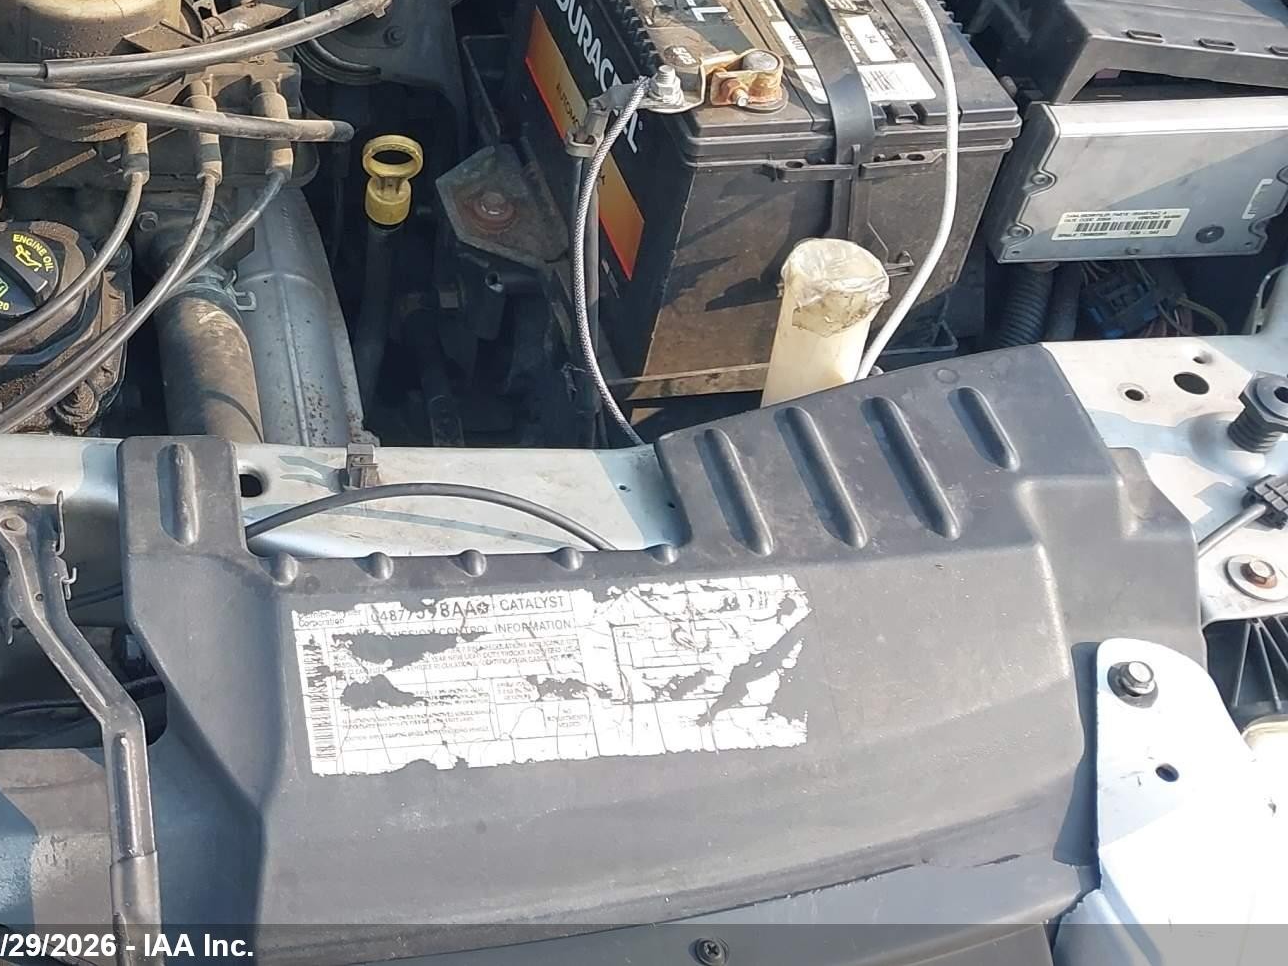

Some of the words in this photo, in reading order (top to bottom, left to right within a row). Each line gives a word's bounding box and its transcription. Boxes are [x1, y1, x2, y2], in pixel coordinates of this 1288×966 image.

[12, 233, 48, 257] ENGINE
[42, 256, 55, 273] OIL
[498, 595, 564, 611] CATALYST
[298, 617, 345, 628] Corporation
[438, 625, 489, 635] CONTROL
[494, 619, 572, 634] INFORMATION
